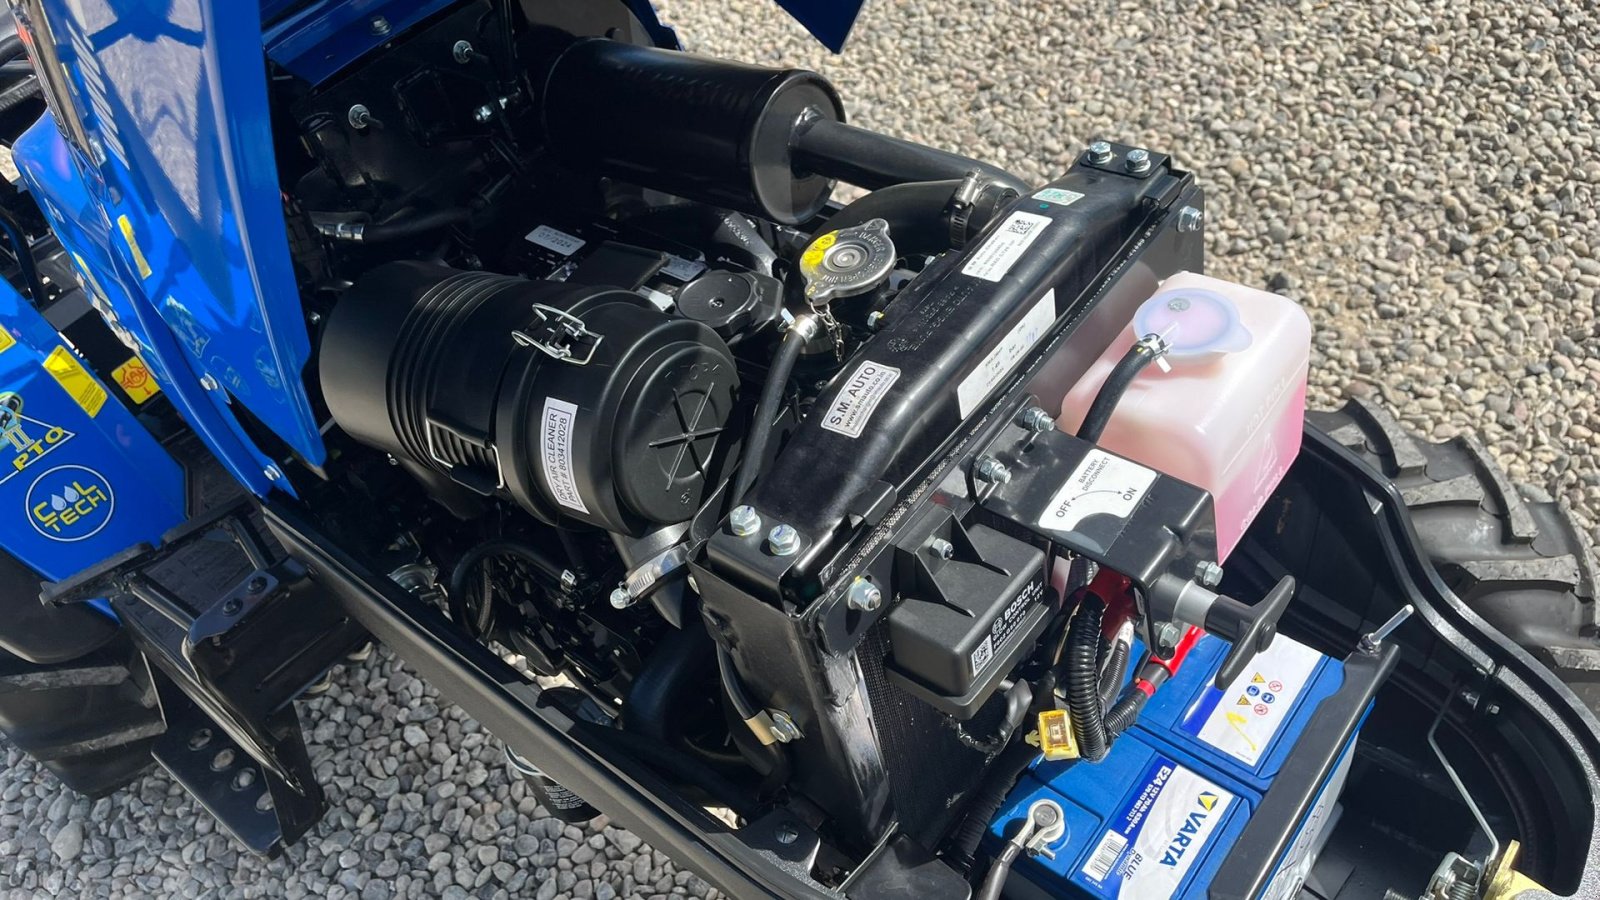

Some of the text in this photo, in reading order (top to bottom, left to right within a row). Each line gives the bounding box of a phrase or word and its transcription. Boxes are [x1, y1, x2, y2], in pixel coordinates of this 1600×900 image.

[830, 400, 853, 425] S.M.
[848, 367, 876, 397] AUTO
[12, 427, 64, 471] PTO
[547, 413, 568, 501] DRY AIR CLEANER
[557, 417, 568, 471] 803412028
[1078, 458, 1100, 484] BATTERY
[1082, 457, 1111, 492] DISCONNECT
[562, 480, 577, 502] PART
[1122, 487, 1138, 501] ON
[45, 489, 108, 533] TECH
[1056, 500, 1072, 518] OFF
[1005, 581, 1034, 620] BOSCH
[1009, 598, 1031, 623] CONTROL
[1032, 581, 1043, 596] UNIT
[1153, 765, 1172, 787] E24
[1139, 798, 1153, 813] 70Ah
[1150, 786, 1160, 799] 12V
[1160, 812, 1207, 867] VARTA
[1116, 848, 1136, 876] Dynamic
[1124, 853, 1143, 880] BLUE
